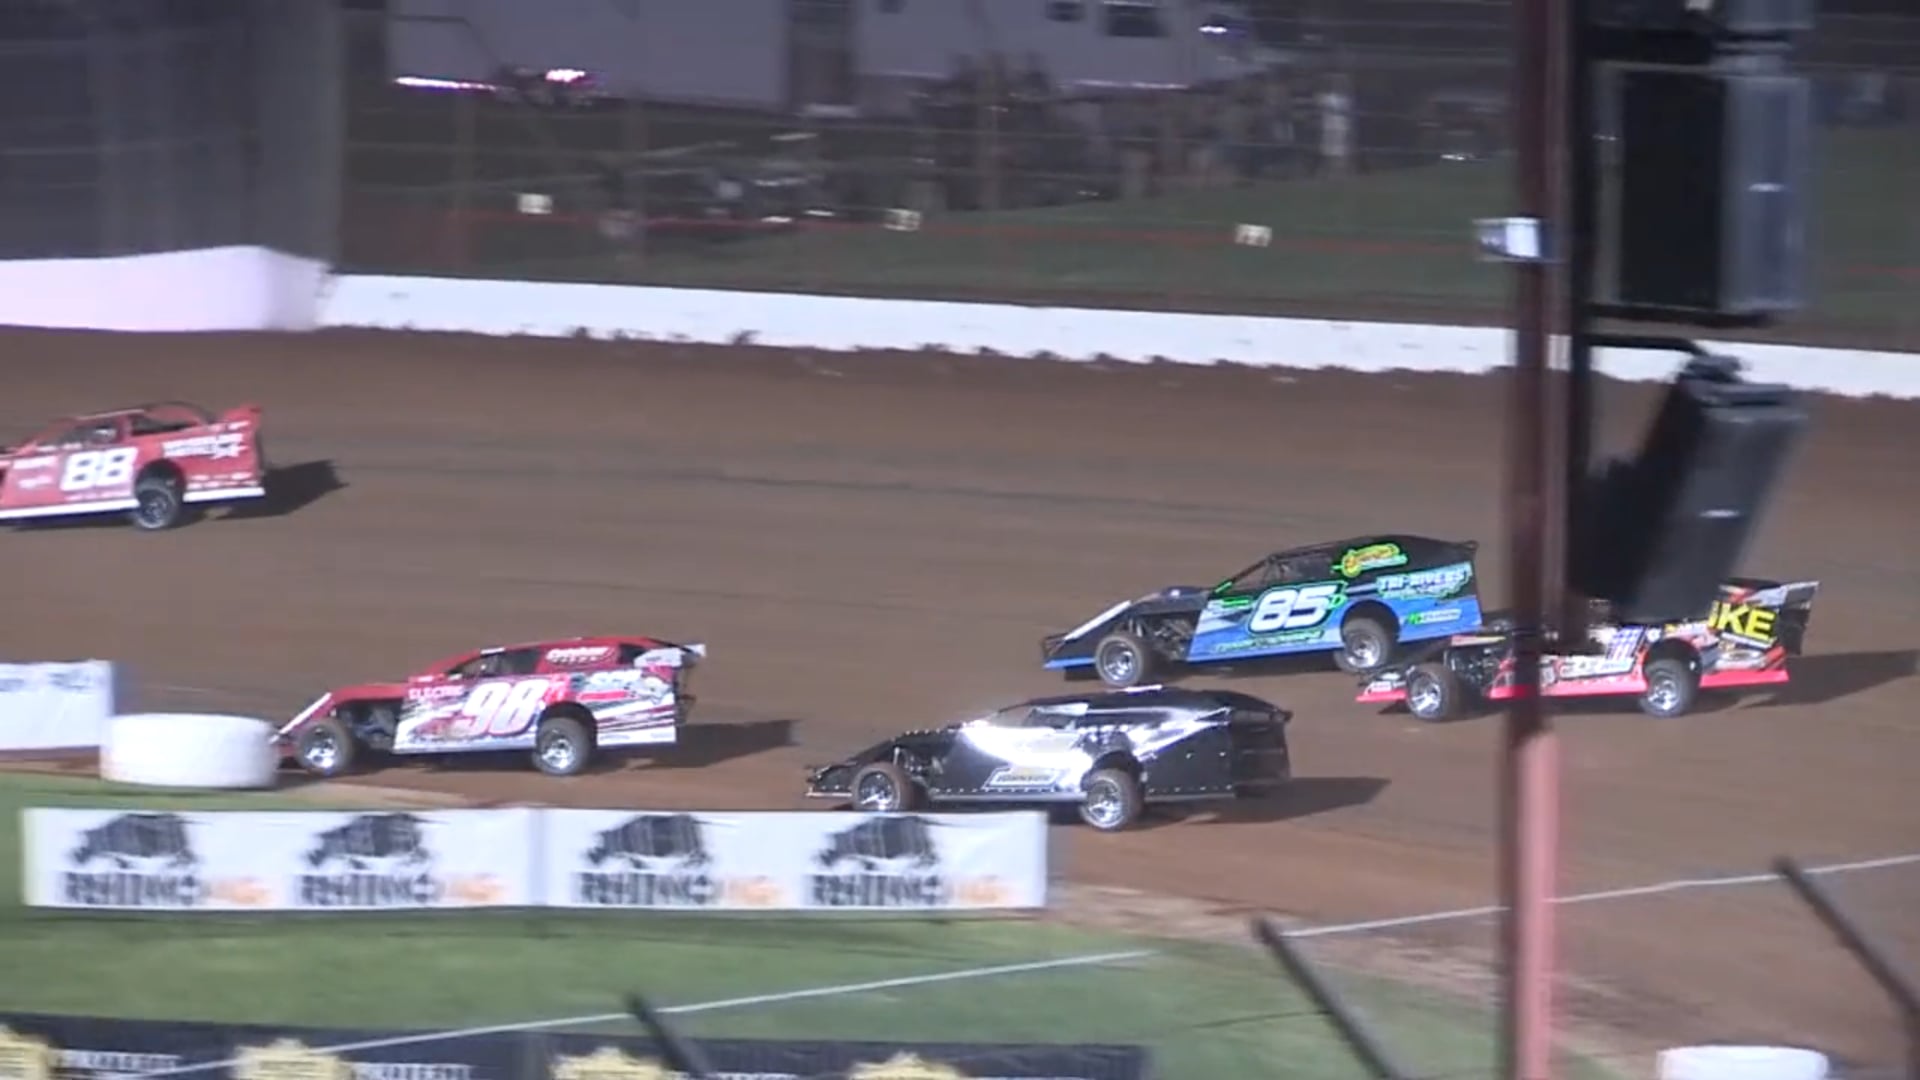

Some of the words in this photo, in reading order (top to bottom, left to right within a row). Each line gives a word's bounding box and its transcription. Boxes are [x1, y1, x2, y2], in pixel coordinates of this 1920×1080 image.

[60, 447, 138, 490] 88
[1250, 584, 1338, 633] 85
[455, 679, 550, 736] 98
